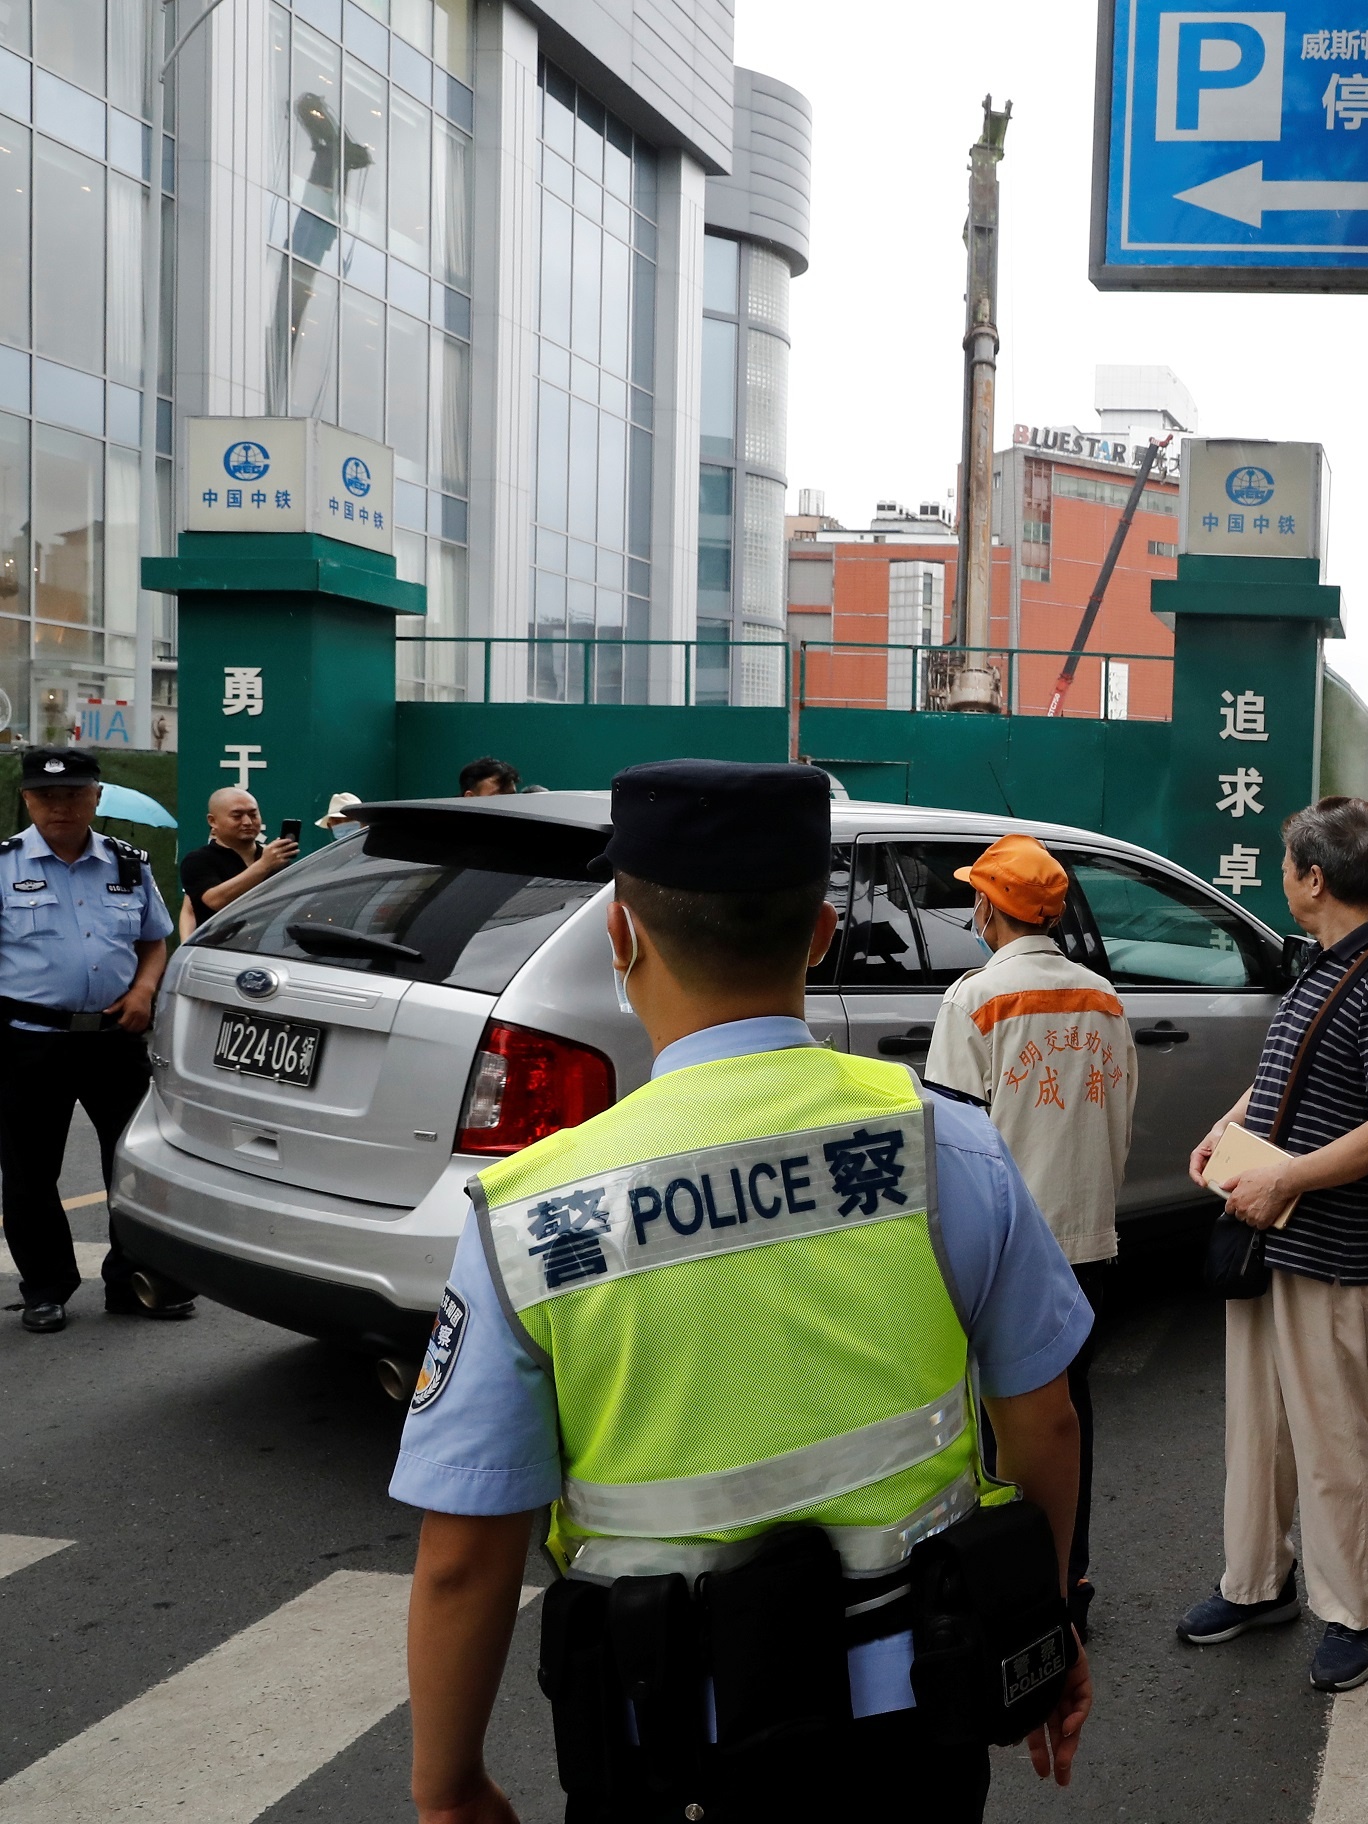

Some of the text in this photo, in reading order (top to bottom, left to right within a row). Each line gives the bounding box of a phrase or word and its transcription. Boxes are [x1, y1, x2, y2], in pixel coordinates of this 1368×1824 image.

[1174, 21, 1266, 131] P
[1013, 423, 1127, 463] BLUESTAR
[202, 488, 292, 509] 中国中铁
[328, 497, 384, 530] 中国中铁
[1202, 512, 1296, 535] 中国中铁
[220, 666, 268, 791] 勇于
[1034, 1063, 1107, 1111] 成都
[823, 1127, 909, 1219] 察
[627, 1156, 816, 1246] POLICE
[528, 1186, 613, 1289] 警
[1009, 1655, 1062, 1698] POLICE
